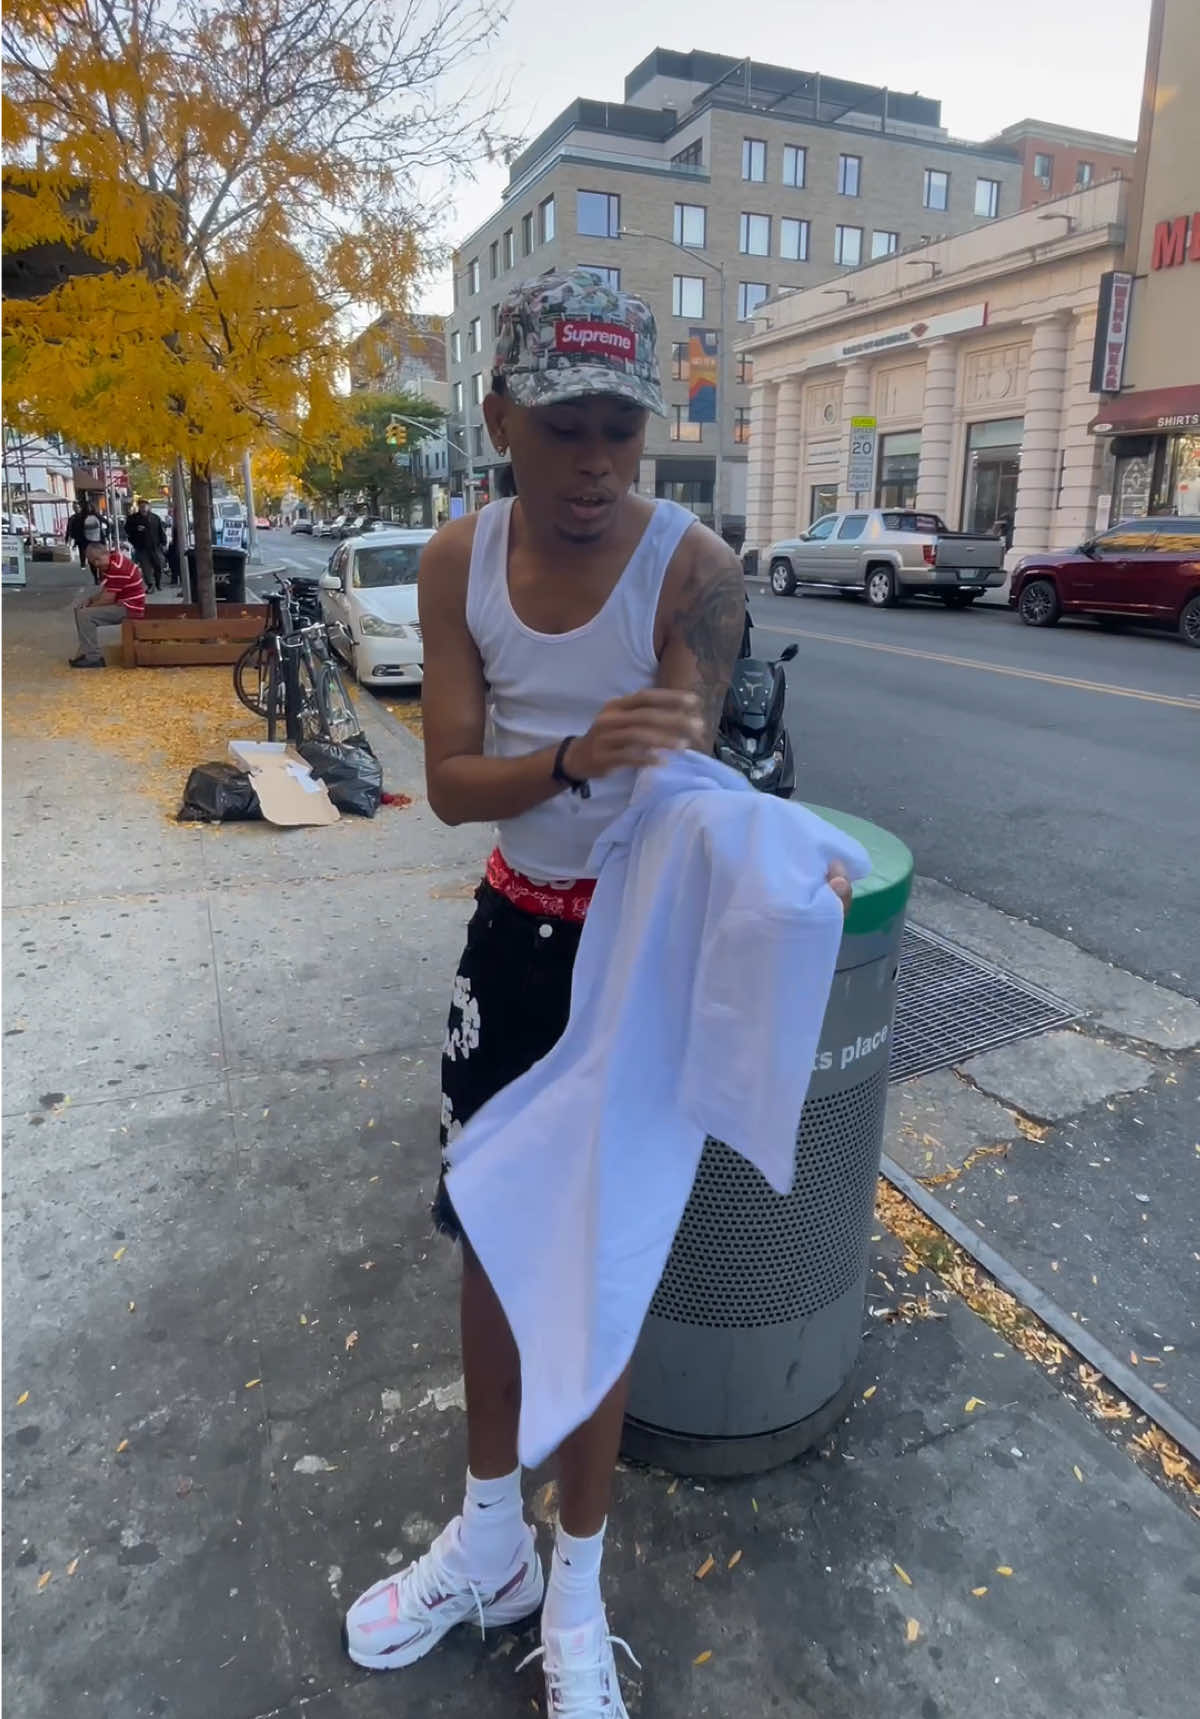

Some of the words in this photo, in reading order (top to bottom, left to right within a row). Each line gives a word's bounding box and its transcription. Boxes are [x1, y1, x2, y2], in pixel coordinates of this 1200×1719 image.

[562, 324, 631, 349] Supreme
[1157, 414, 1199, 427] SHIRTS
[852, 442, 872, 454] 20
[840, 1025, 888, 1070] place
